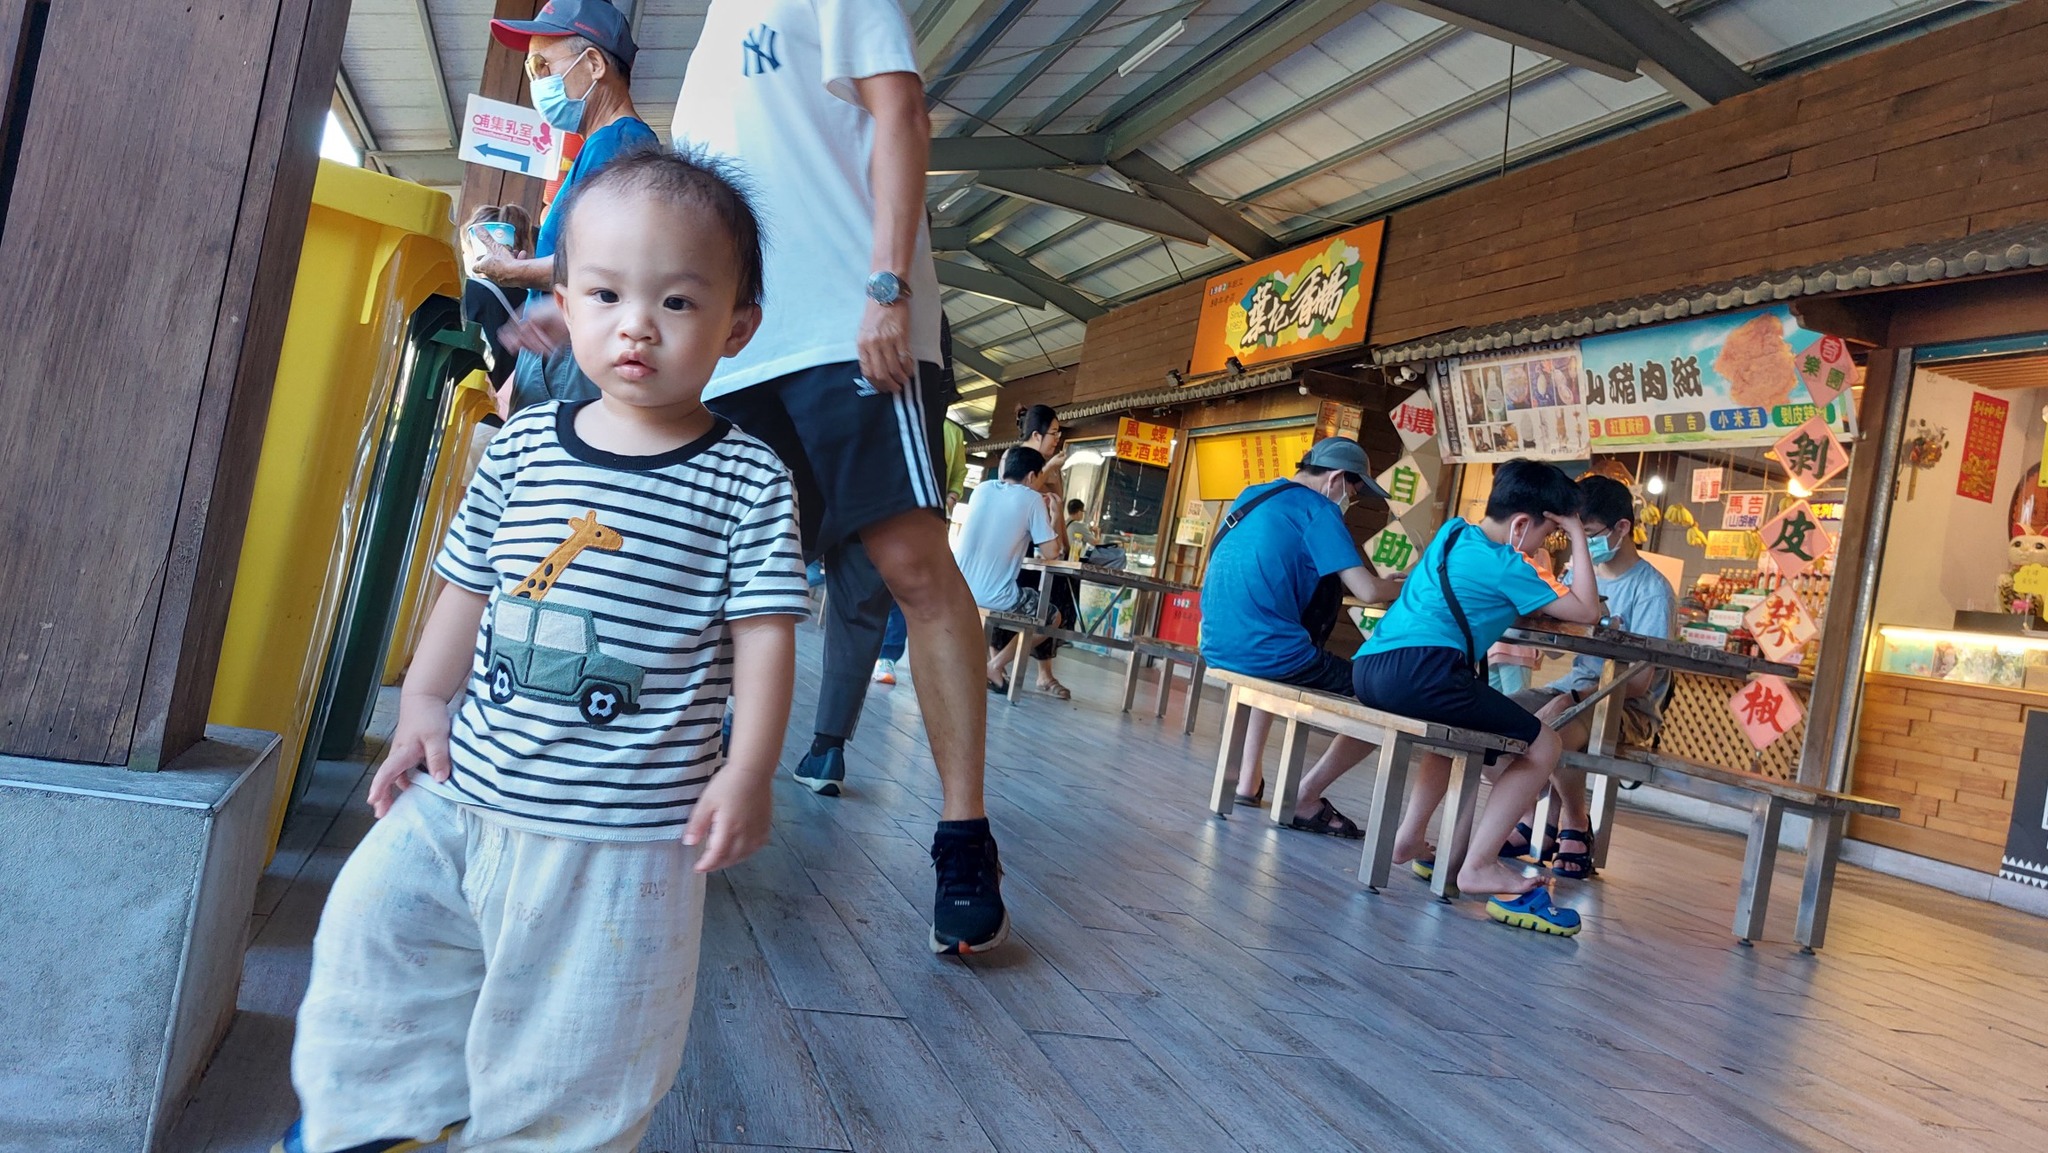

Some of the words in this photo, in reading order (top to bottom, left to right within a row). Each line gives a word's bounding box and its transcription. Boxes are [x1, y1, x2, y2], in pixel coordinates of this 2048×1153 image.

[1663, 413, 1697, 432] 馬告
[1718, 409, 1761, 429] 小米酒
[1117, 440, 1169, 463] 燒酒螺
[1727, 495, 1763, 514] 馬告
